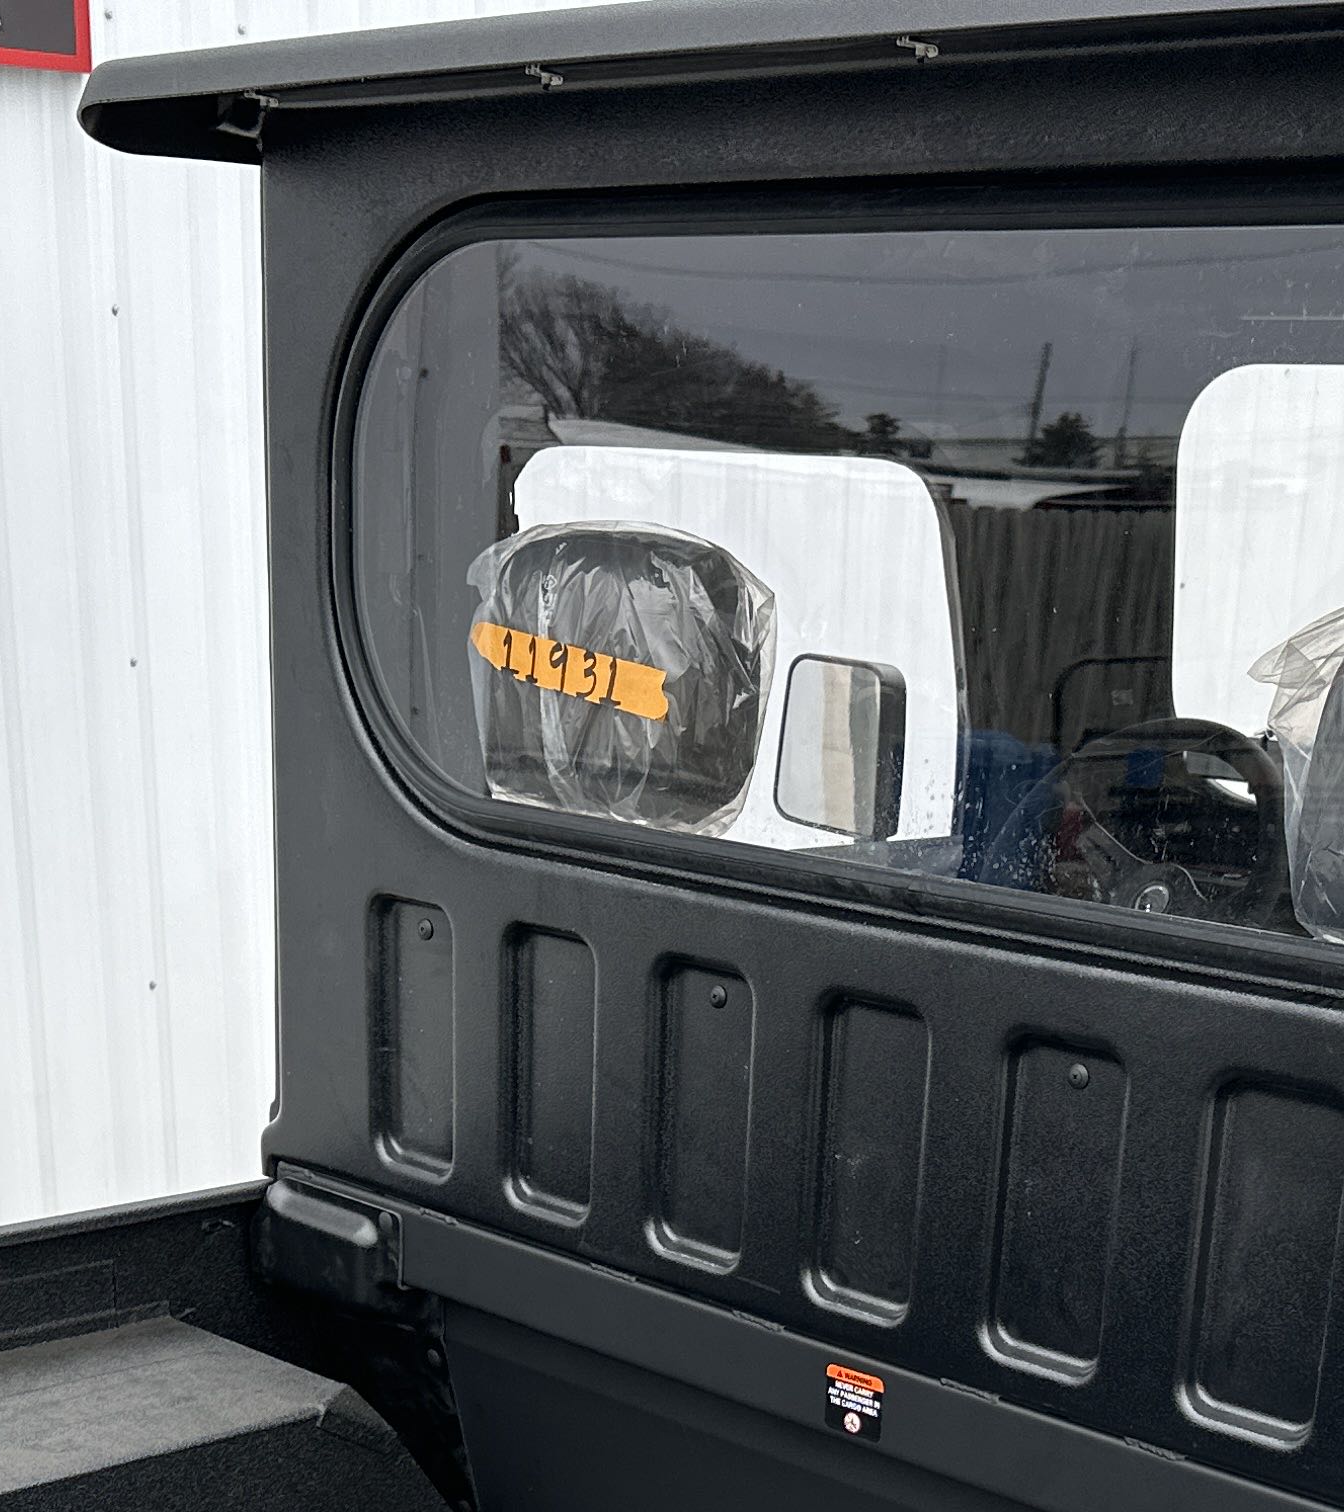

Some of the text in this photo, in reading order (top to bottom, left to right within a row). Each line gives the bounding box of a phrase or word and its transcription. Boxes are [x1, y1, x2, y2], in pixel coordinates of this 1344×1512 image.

[502, 629, 622, 707] 11931
[844, 1373, 872, 1386] WARNING
[835, 1380, 874, 1399] NEVER CARRY
